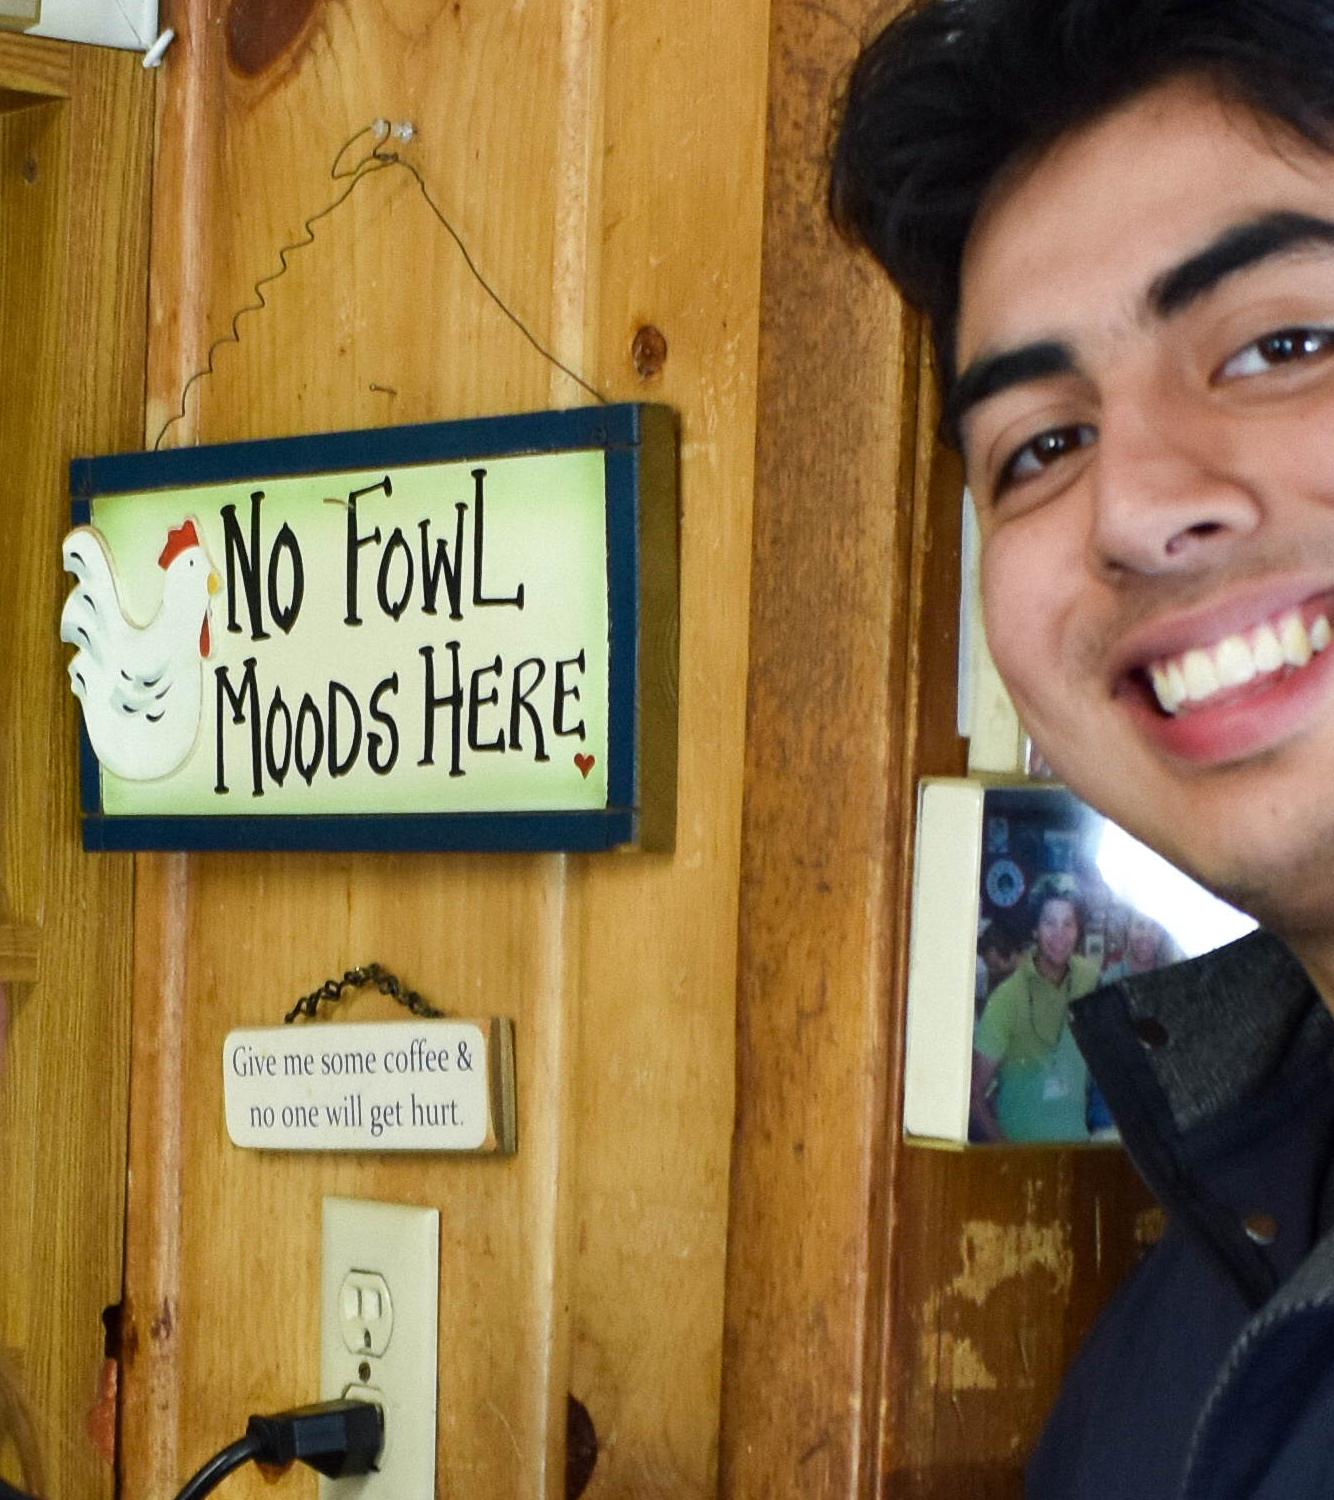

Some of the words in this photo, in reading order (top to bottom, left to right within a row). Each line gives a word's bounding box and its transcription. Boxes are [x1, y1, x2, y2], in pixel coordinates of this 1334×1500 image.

[344, 468, 525, 626] FOWL
[214, 656, 399, 797] MOODS
[417, 640, 586, 777] HERE
[232, 1045, 277, 1077] Give
[283, 1053, 315, 1076] me
[321, 1049, 377, 1076] some
[383, 1038, 450, 1074] coffee
[456, 1040, 473, 1072] &
[249, 1104, 276, 1128] no
[281, 1103, 320, 1128] one
[325, 1094, 363, 1128] will
[369, 1099, 404, 1138] get
[410, 1093, 465, 1128] hurt.
